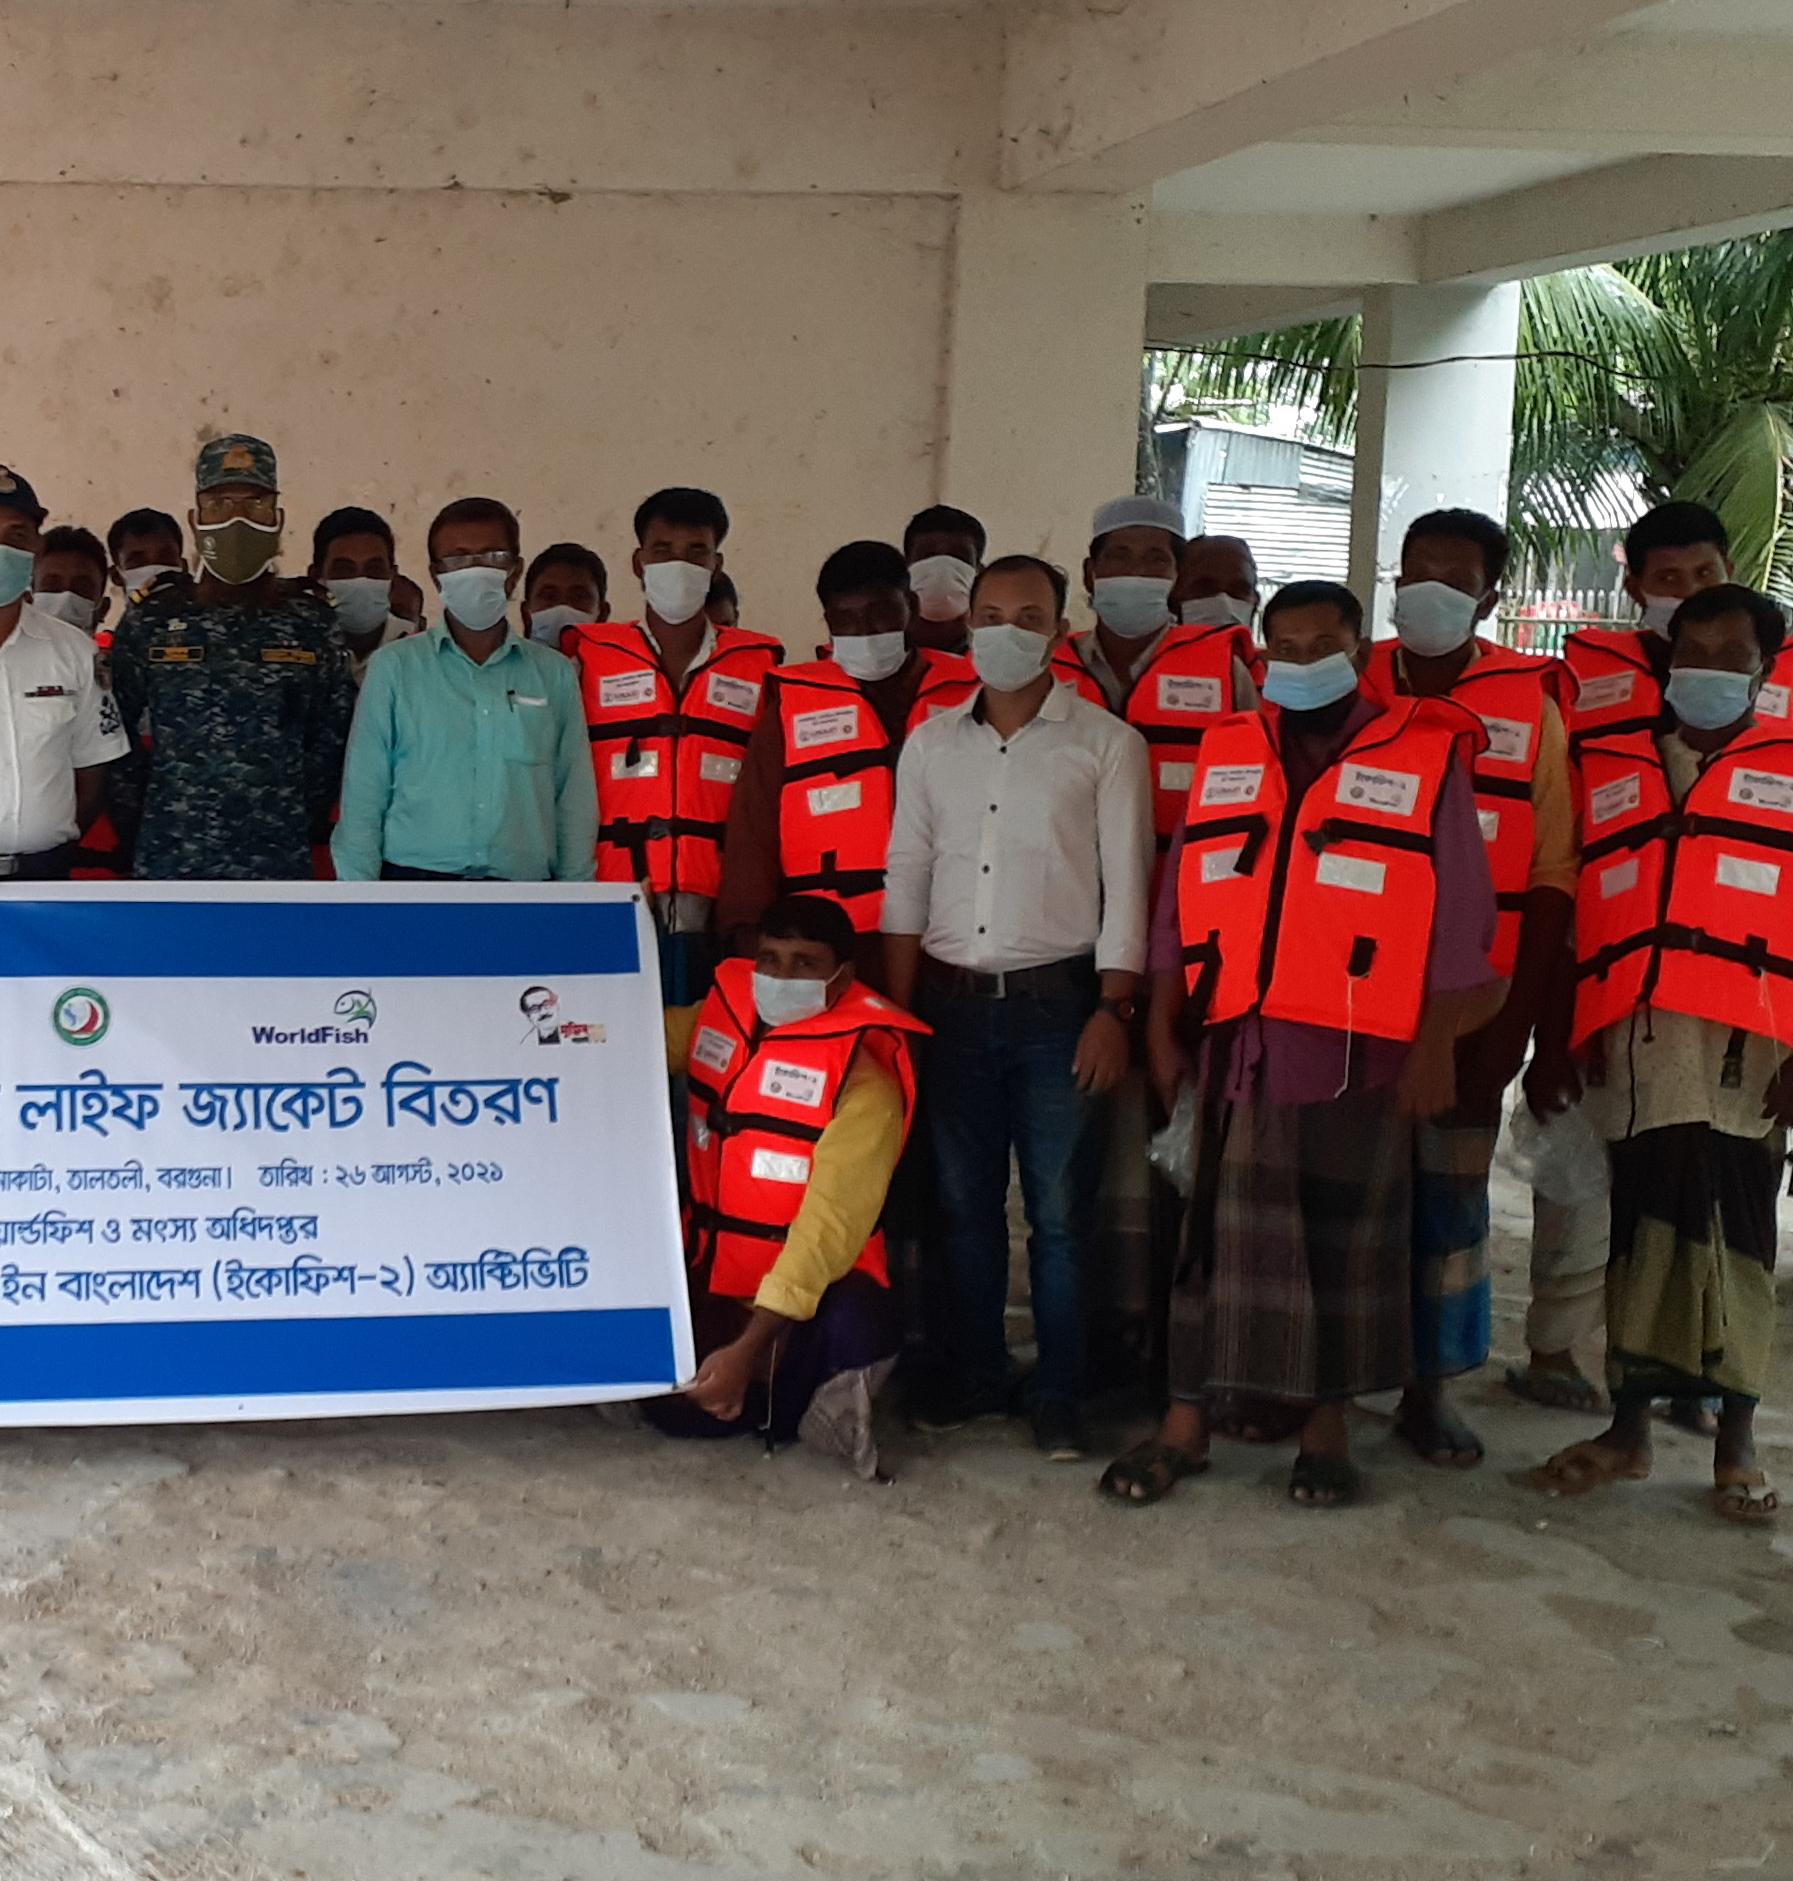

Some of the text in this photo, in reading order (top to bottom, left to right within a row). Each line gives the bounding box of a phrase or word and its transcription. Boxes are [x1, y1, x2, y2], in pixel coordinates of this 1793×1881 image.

[251, 1025, 370, 1045] WorldFish
[15, 1068, 164, 1137] লাইফ
[178, 1066, 367, 1133] জ্যাকেট
[380, 1060, 560, 1128] বিতরণ
[257, 1157, 314, 1188] তারিখ
[335, 1165, 367, 1188] ২৬
[447, 1162, 504, 1185] ২০২১
[100, 1218, 121, 1244] ও
[129, 1217, 198, 1243] মৎস্য
[205, 1206, 319, 1245] অধিদপ্তর
[0, 1263, 48, 1306] ইন
[55, 1269, 202, 1304] বাংলাদেশ
